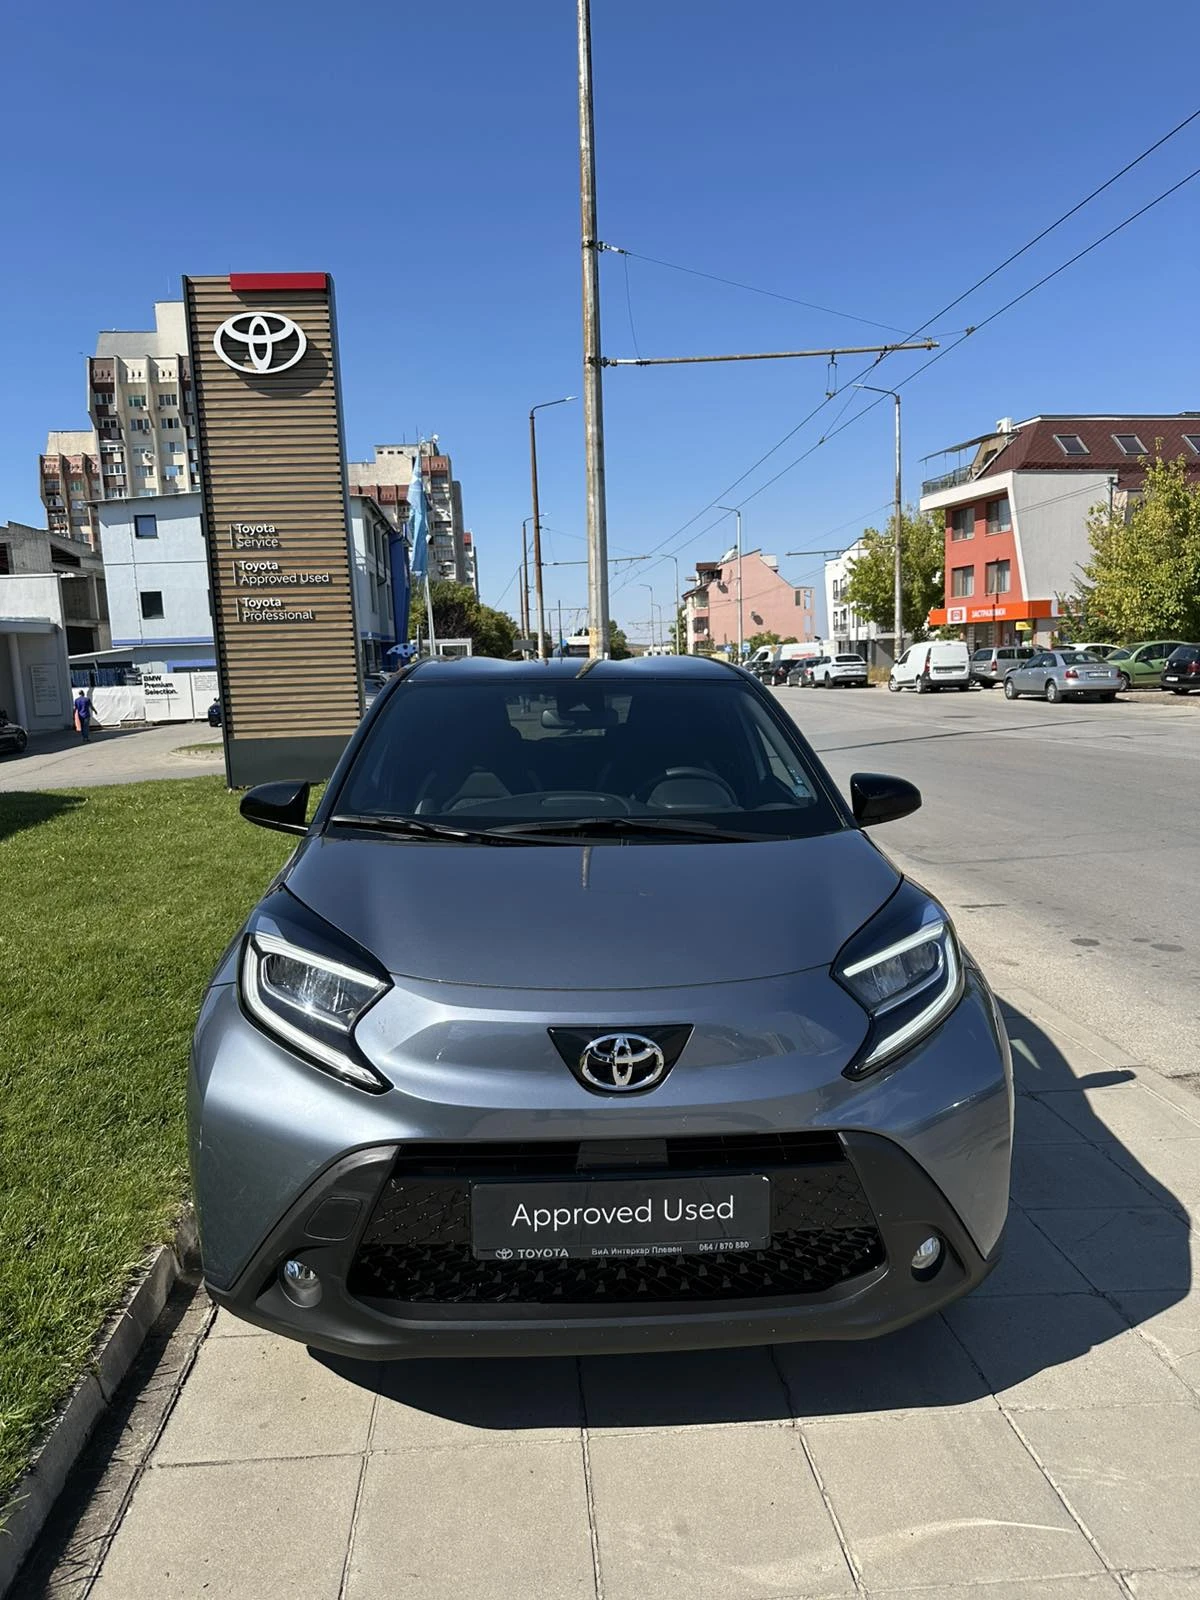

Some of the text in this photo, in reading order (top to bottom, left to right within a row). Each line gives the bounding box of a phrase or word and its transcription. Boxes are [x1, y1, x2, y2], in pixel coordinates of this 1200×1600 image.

[236, 523, 275, 535] Toyota
[236, 537, 279, 548] Service
[239, 560, 279, 572] Toyota
[241, 572, 329, 585] Approved Used
[242, 597, 282, 609] Toyota
[243, 609, 313, 621] Professional
[511, 1195, 734, 1232] Approved Used
[517, 1247, 569, 1259] TOYOTA
[611, 1246, 650, 1256] Интеркар
[652, 1246, 682, 1254] Плевен
